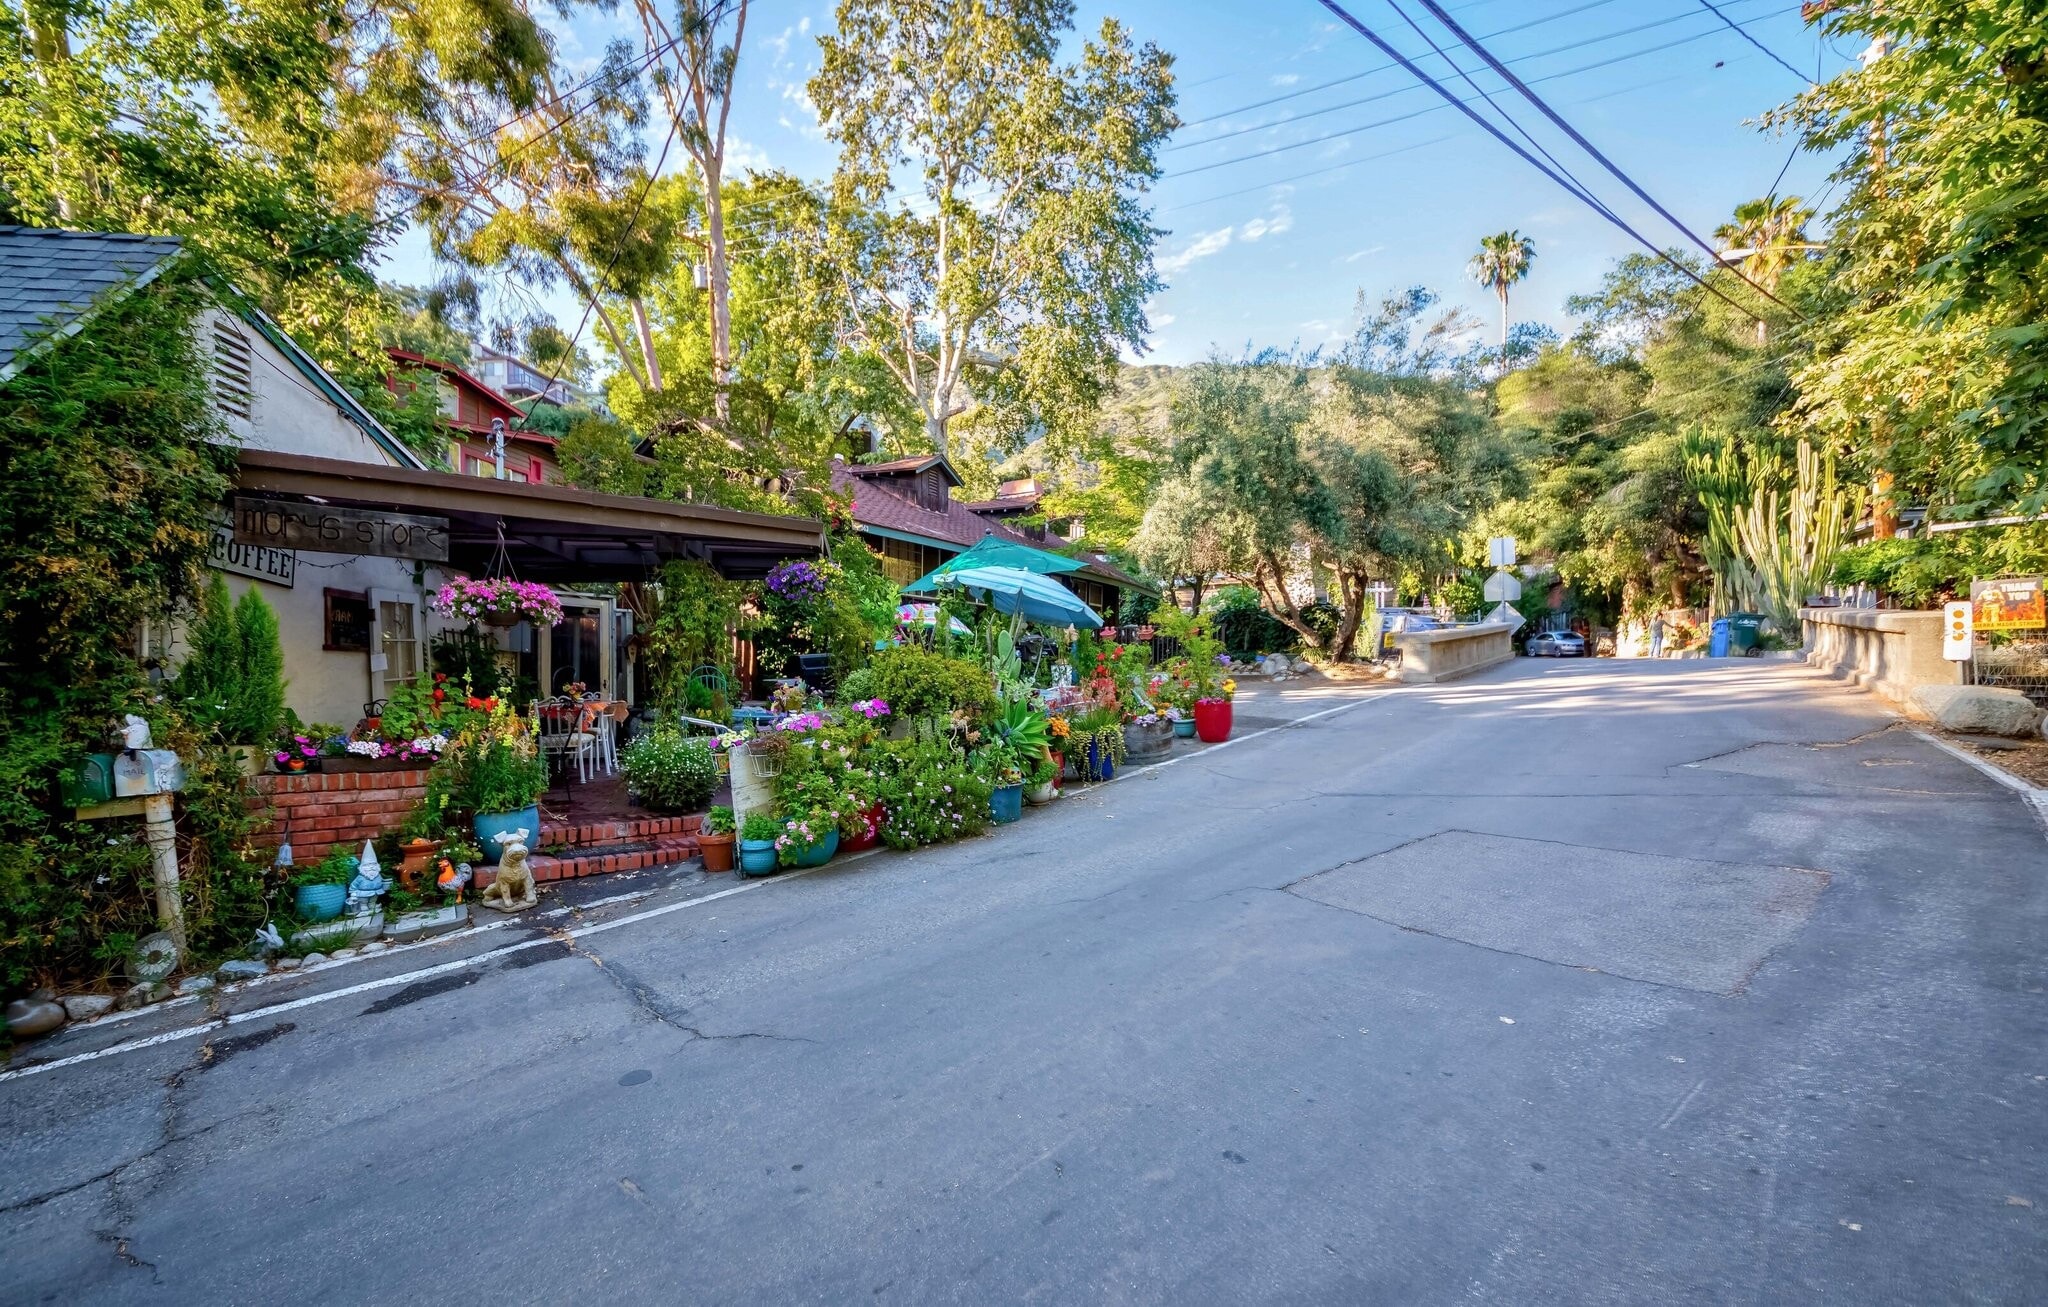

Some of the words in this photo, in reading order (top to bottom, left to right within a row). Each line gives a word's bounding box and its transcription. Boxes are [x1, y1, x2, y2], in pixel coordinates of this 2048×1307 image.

[242, 508, 340, 540] mary's
[356, 519, 446, 550] store
[213, 532, 292, 578] COFFEE
[2000, 581, 2036, 593] THANK
[2008, 591, 2030, 601] YOU
